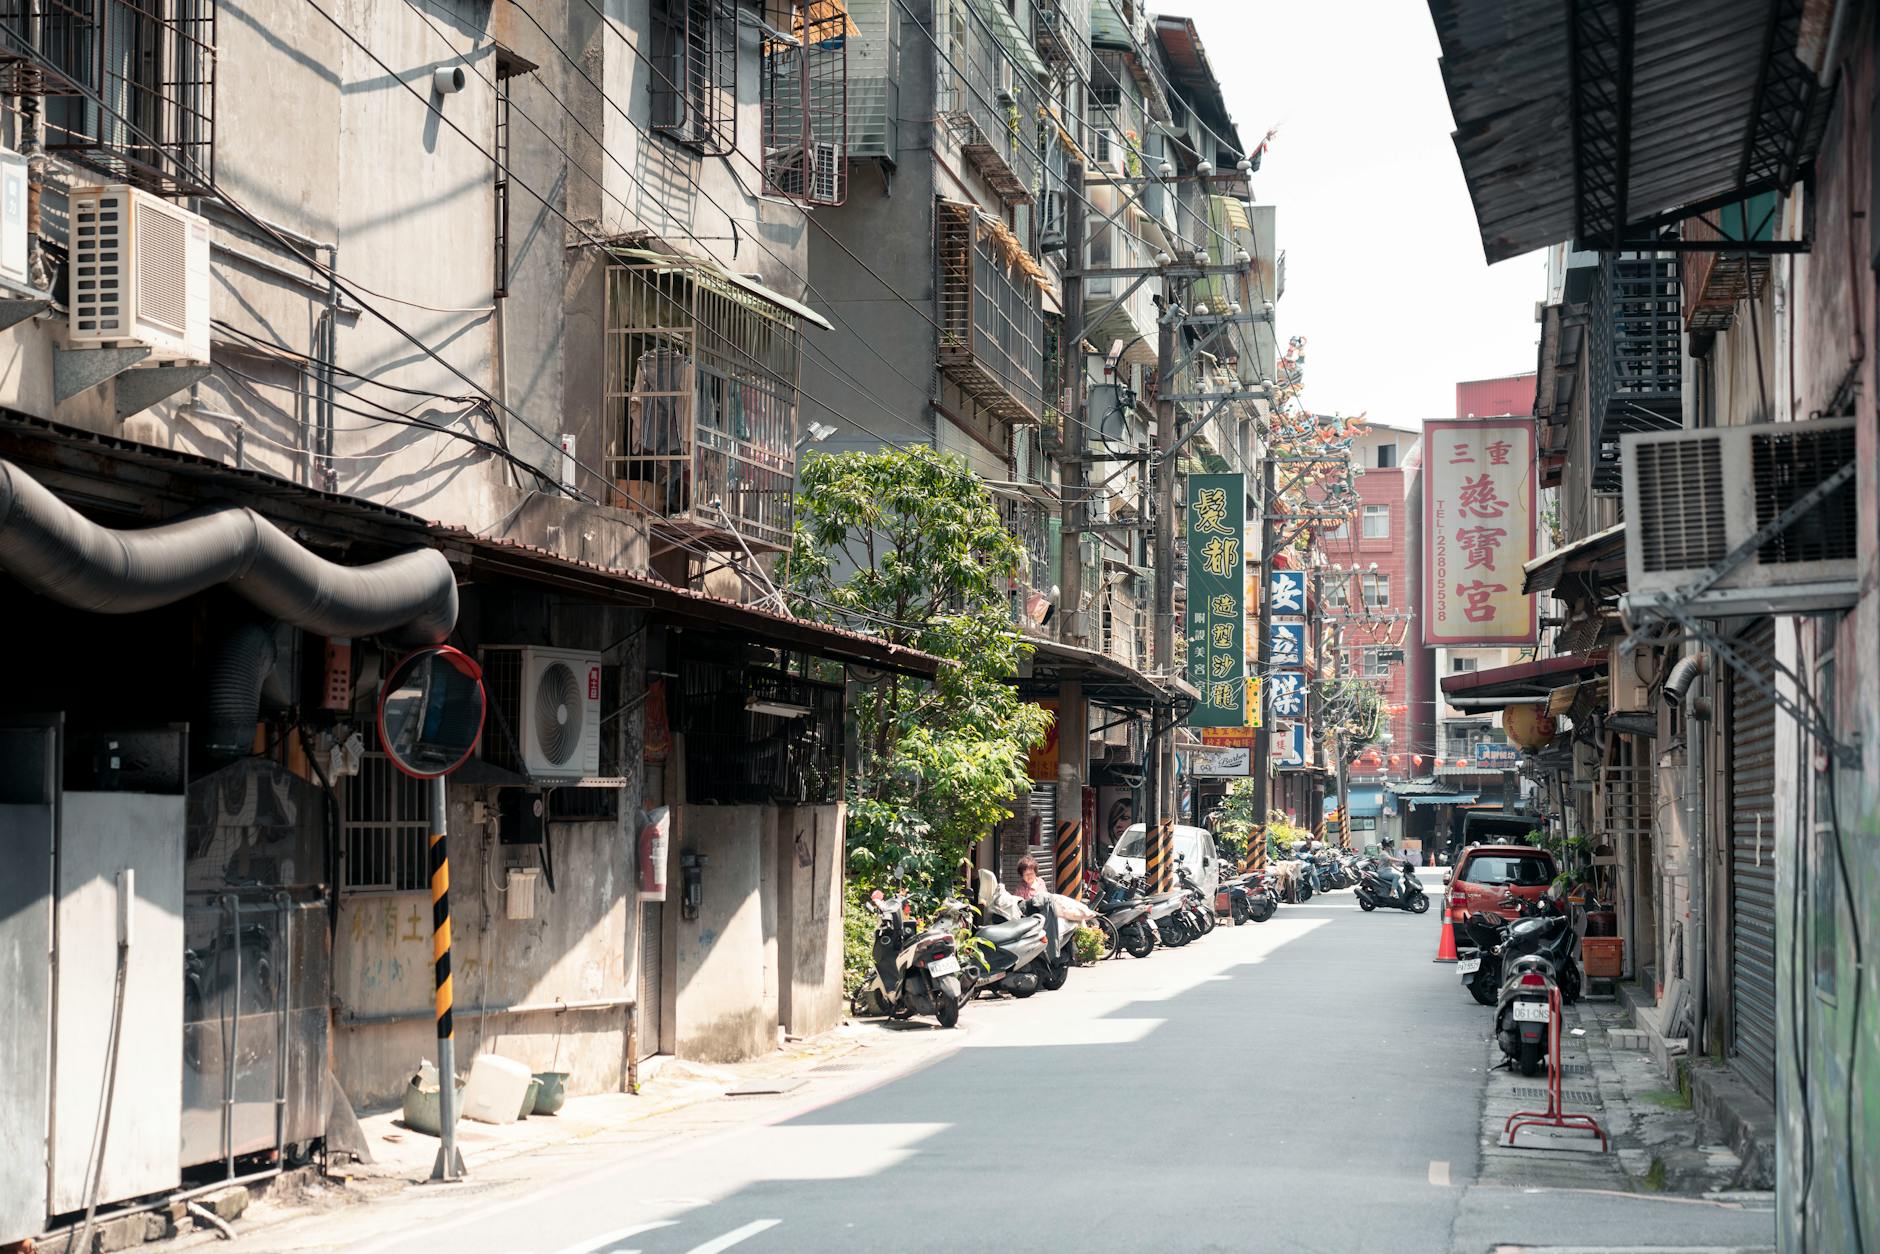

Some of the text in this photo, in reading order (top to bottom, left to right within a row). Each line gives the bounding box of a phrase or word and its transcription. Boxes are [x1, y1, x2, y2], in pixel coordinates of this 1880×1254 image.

[1449, 440, 1512, 465] 三重
[1192, 488, 1238, 578] 髮都
[1455, 473, 1509, 623] 慈寶宮
[1212, 594, 1239, 709] 造型沙龍
